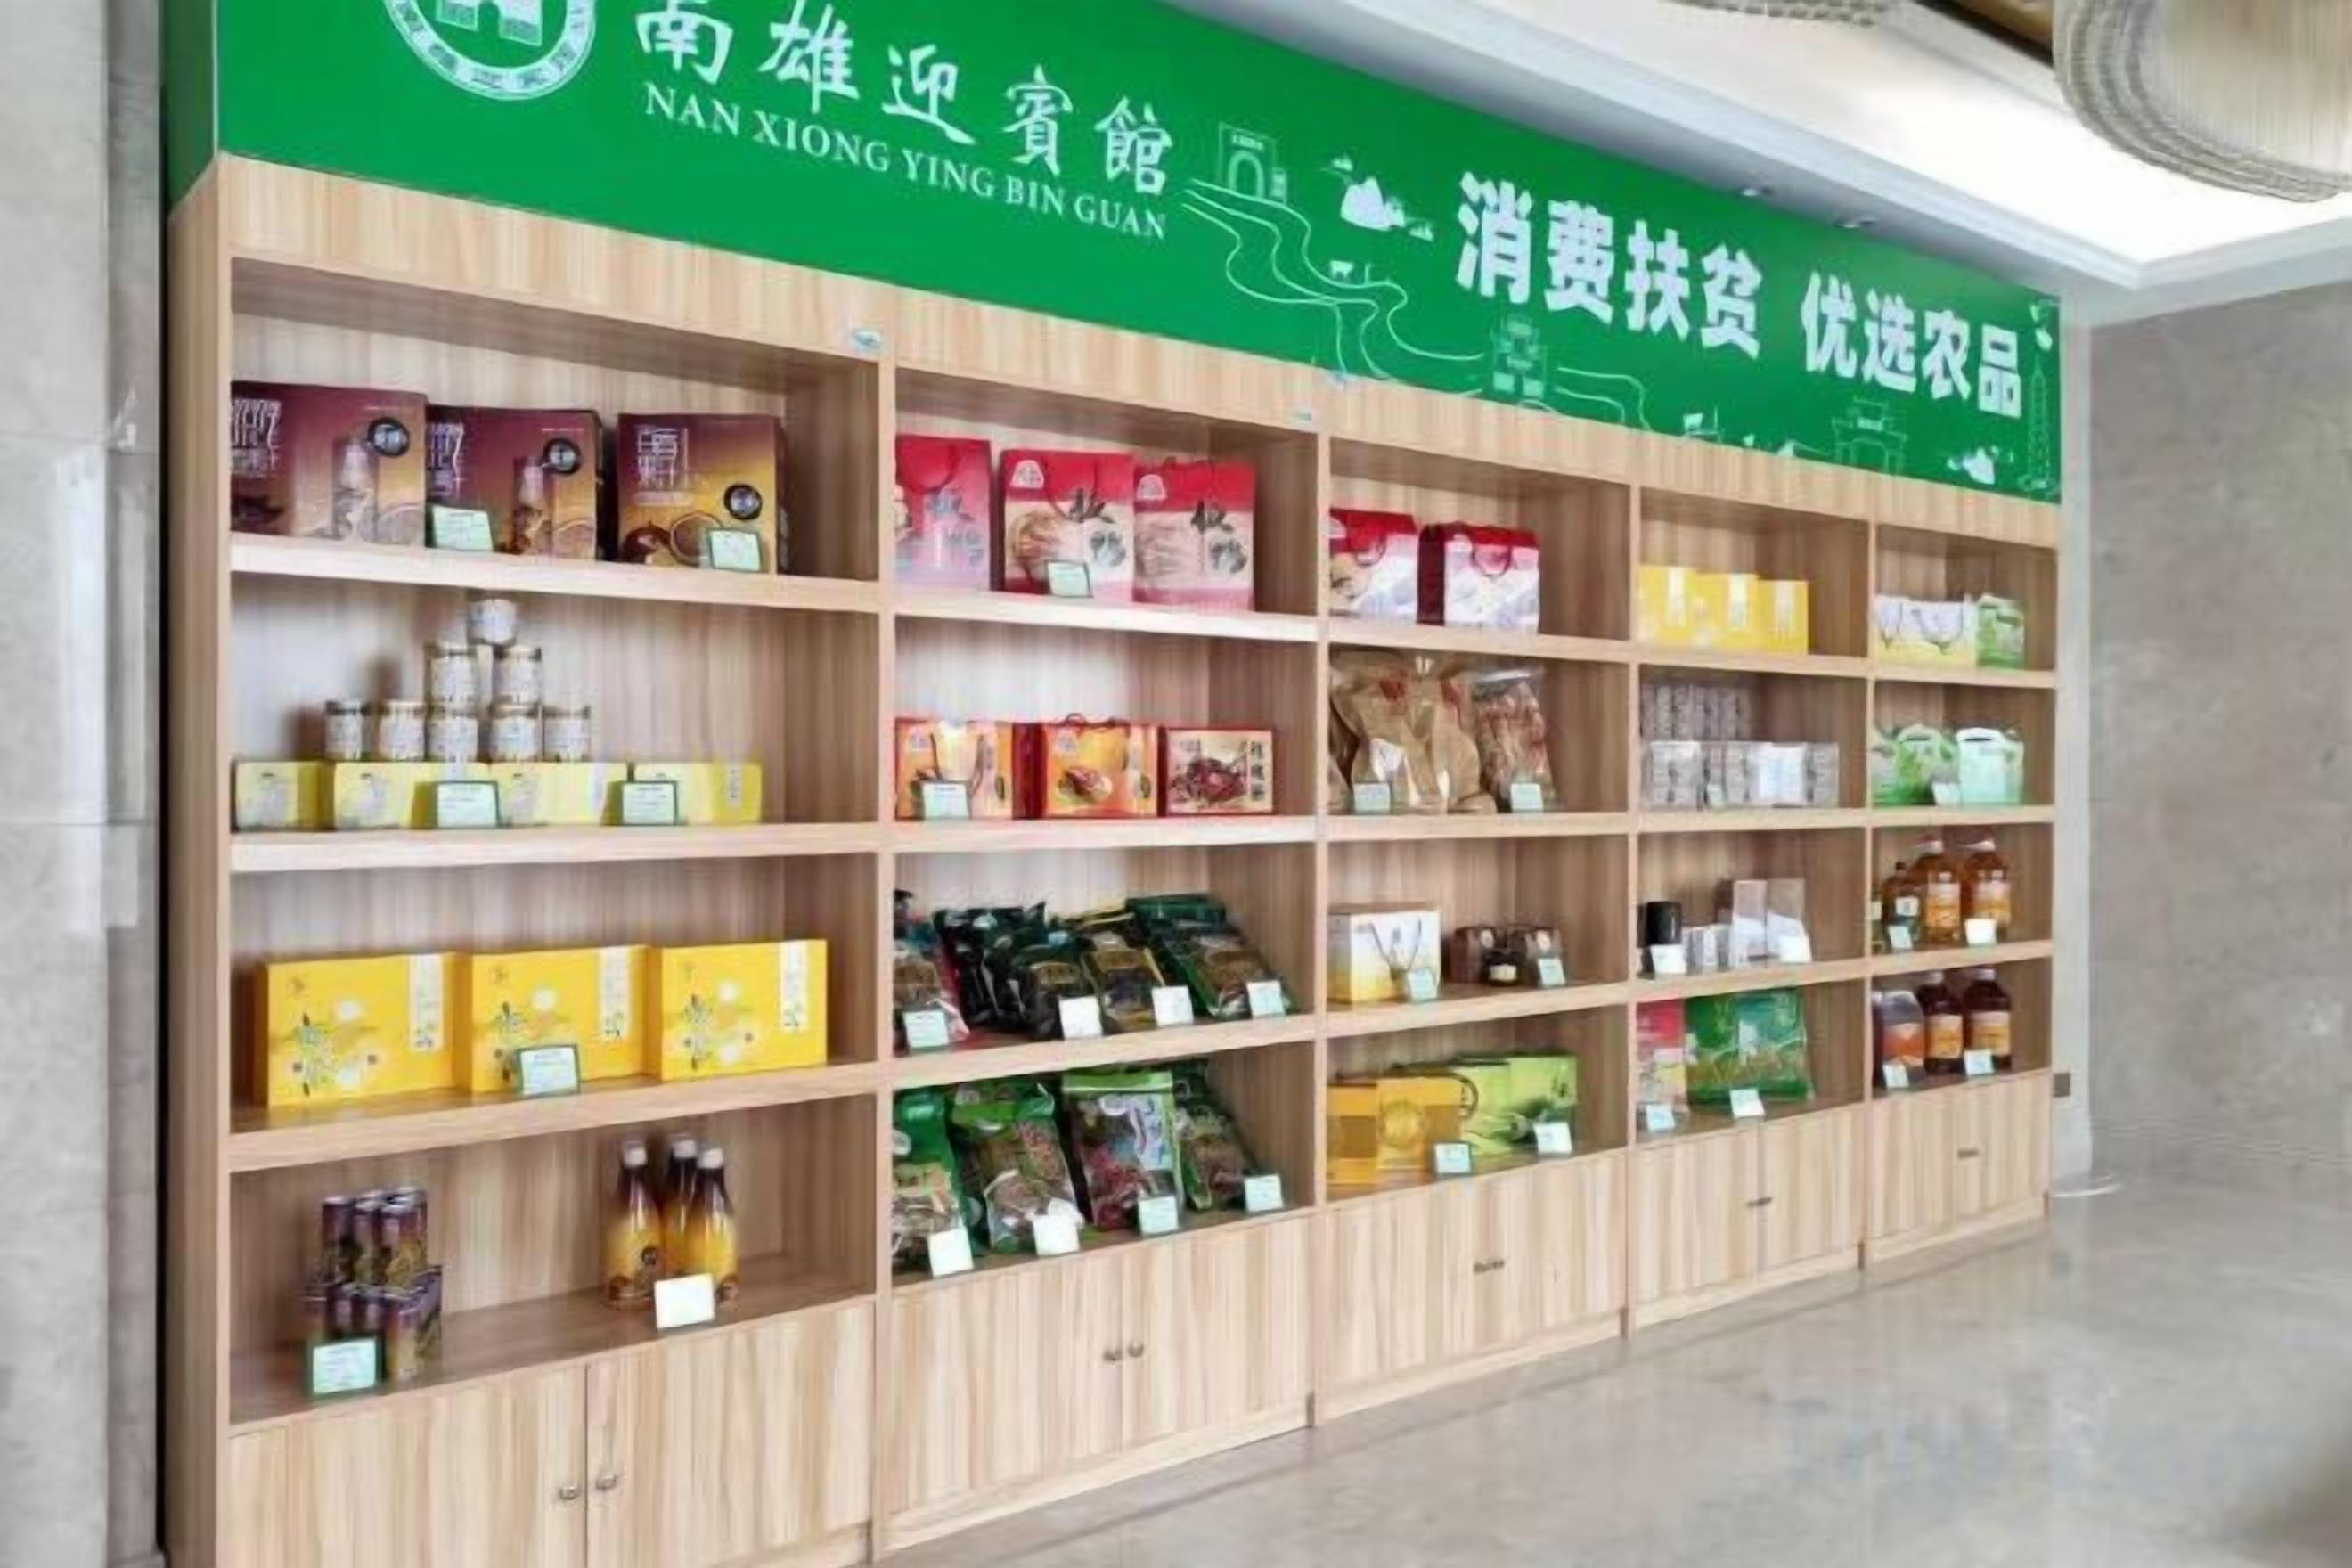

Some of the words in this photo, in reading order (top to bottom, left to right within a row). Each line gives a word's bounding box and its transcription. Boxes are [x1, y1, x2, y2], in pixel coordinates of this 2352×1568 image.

[635, 0, 1173, 195] 南雄迎賓館
[644, 80, 740, 137] NAN
[753, 110, 890, 172] XIONG
[902, 149, 995, 198] YING
[1005, 175, 1066, 216] BIN
[1074, 194, 1167, 240] GUAN
[1457, 171, 1762, 359] 消费扶贫
[1801, 270, 2022, 419] 优选农品
